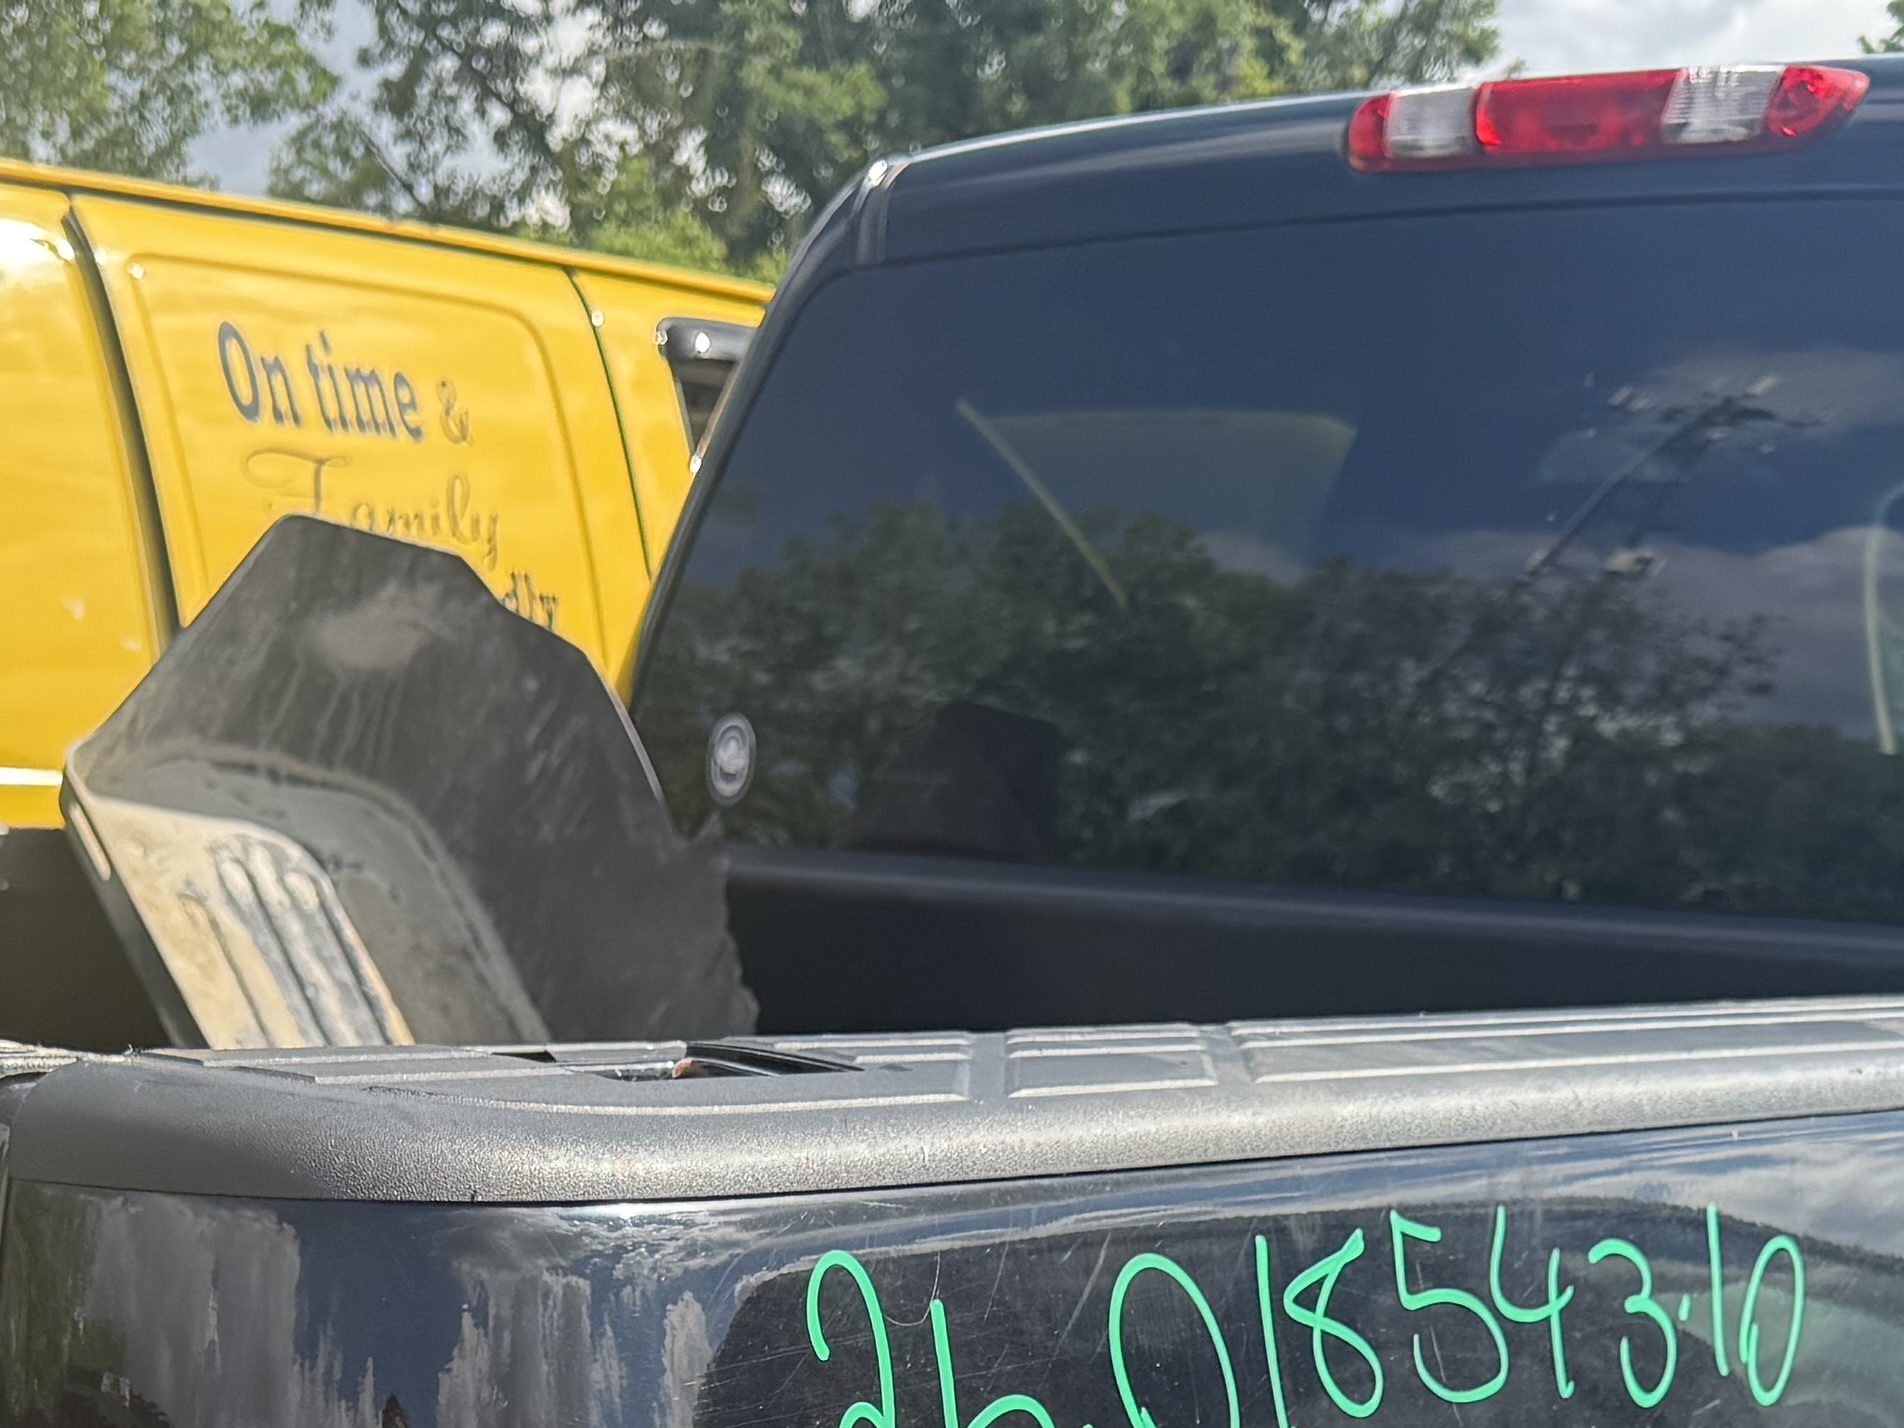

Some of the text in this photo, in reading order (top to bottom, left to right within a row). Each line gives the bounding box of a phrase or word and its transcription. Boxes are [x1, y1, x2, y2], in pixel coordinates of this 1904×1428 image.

[217, 321, 473, 446] On time &
